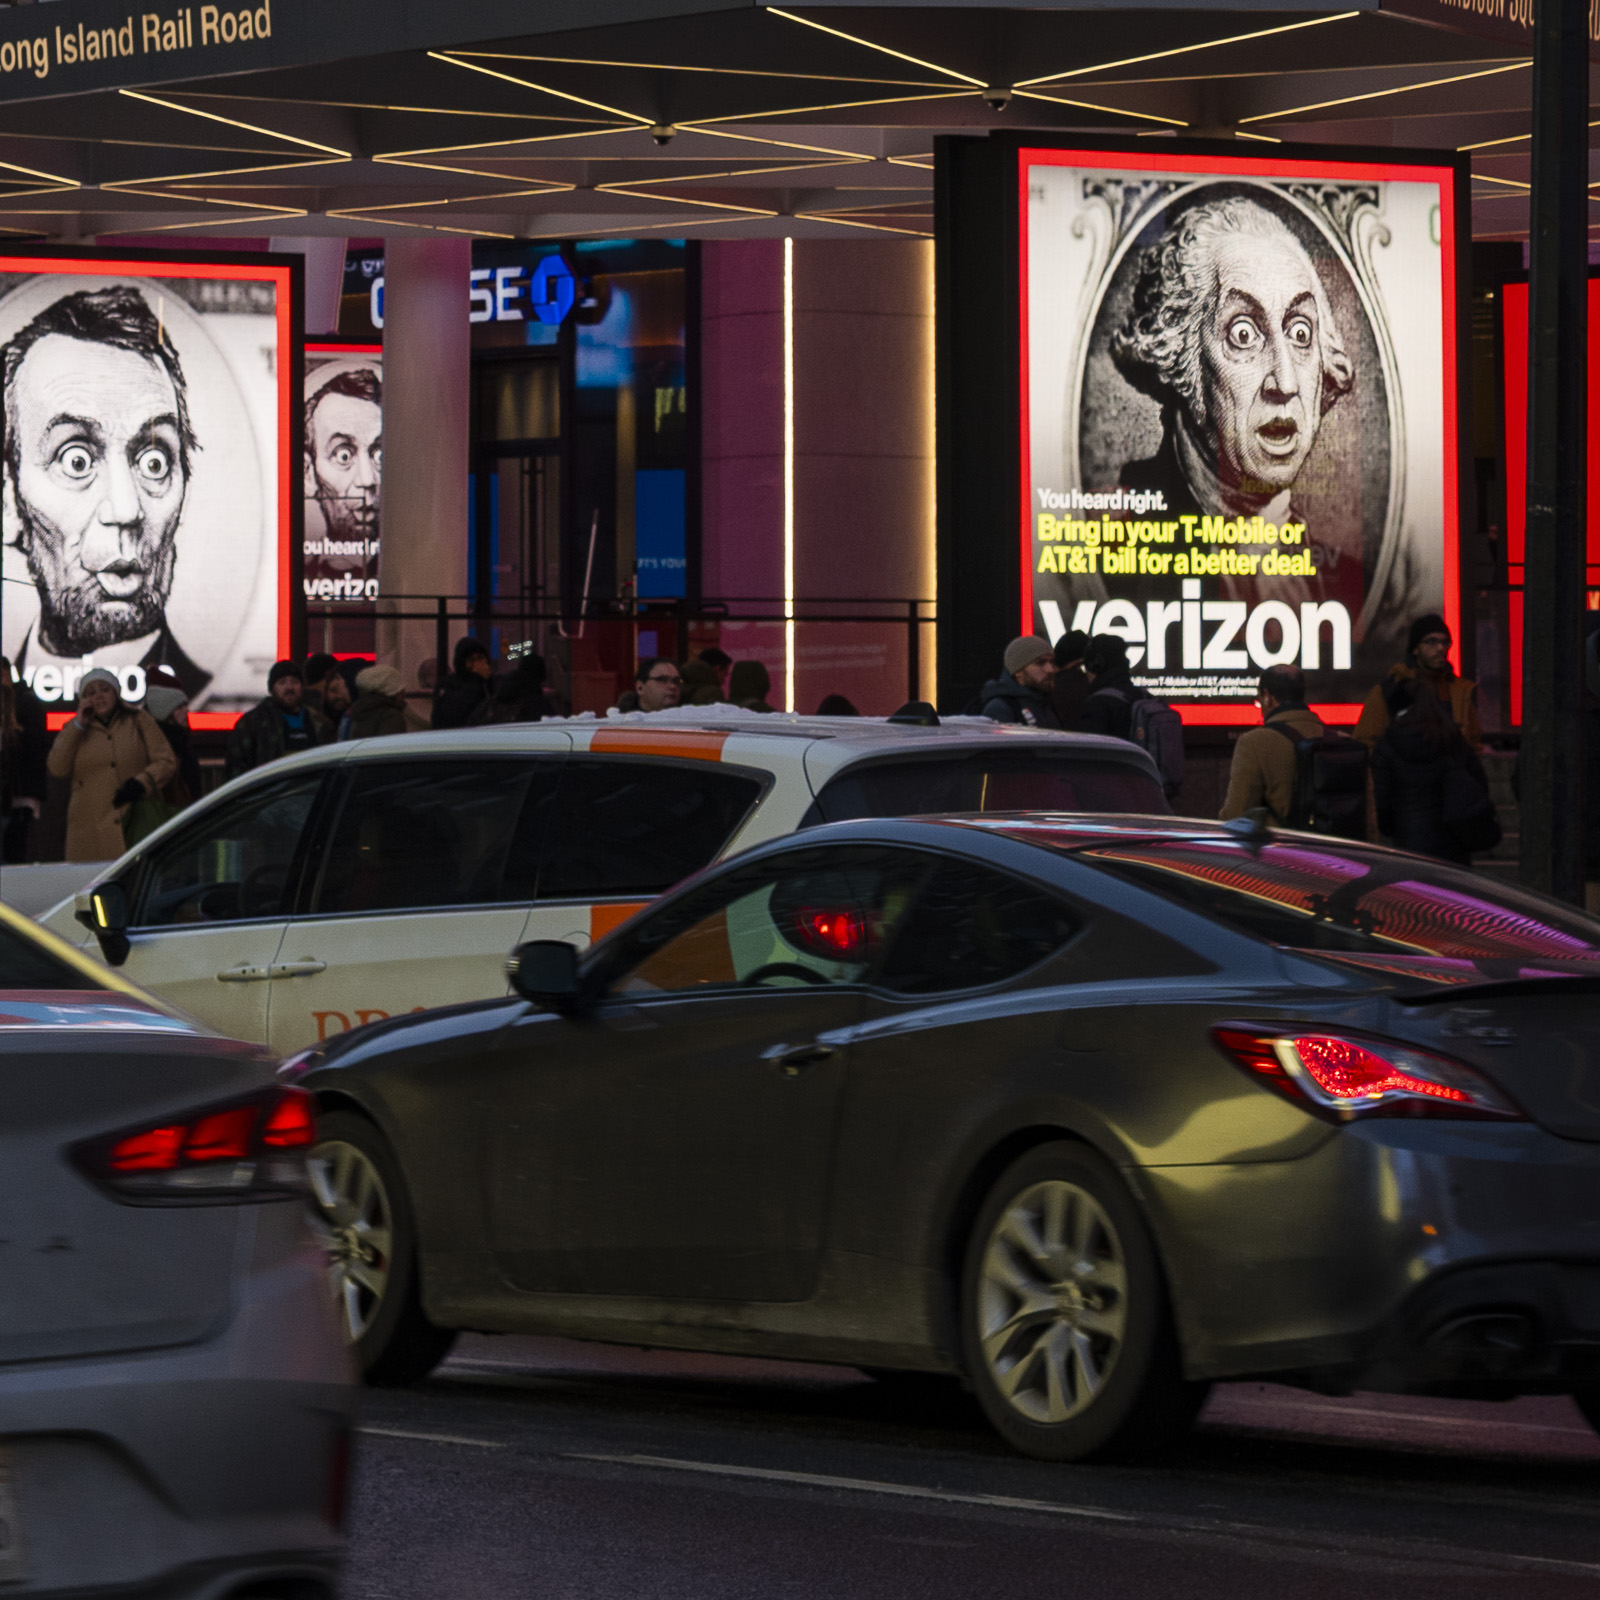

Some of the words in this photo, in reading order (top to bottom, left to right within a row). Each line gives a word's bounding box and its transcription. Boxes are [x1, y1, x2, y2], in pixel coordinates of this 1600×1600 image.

[55, 16, 134, 65] Island
[142, 8, 193, 54] Rail
[1038, 488, 1070, 510] You
[1072, 489, 1123, 512] heard
[1123, 489, 1167, 514] right.
[1038, 513, 1101, 547] Bring
[1102, 516, 1124, 543] in
[1125, 522, 1178, 548] your
[1180, 515, 1279, 545] T-Mobile
[1280, 522, 1305, 545] or
[304, 540, 322, 555] ou
[1038, 547, 1102, 575] AT&T
[1103, 547, 1136, 575] bill
[1138, 548, 1172, 574] for
[1174, 554, 1190, 575] a
[1191, 548, 1261, 575] better
[1262, 549, 1317, 576] deal.
[303, 572, 379, 601] verizo
[1039, 578, 1351, 670] verizon
